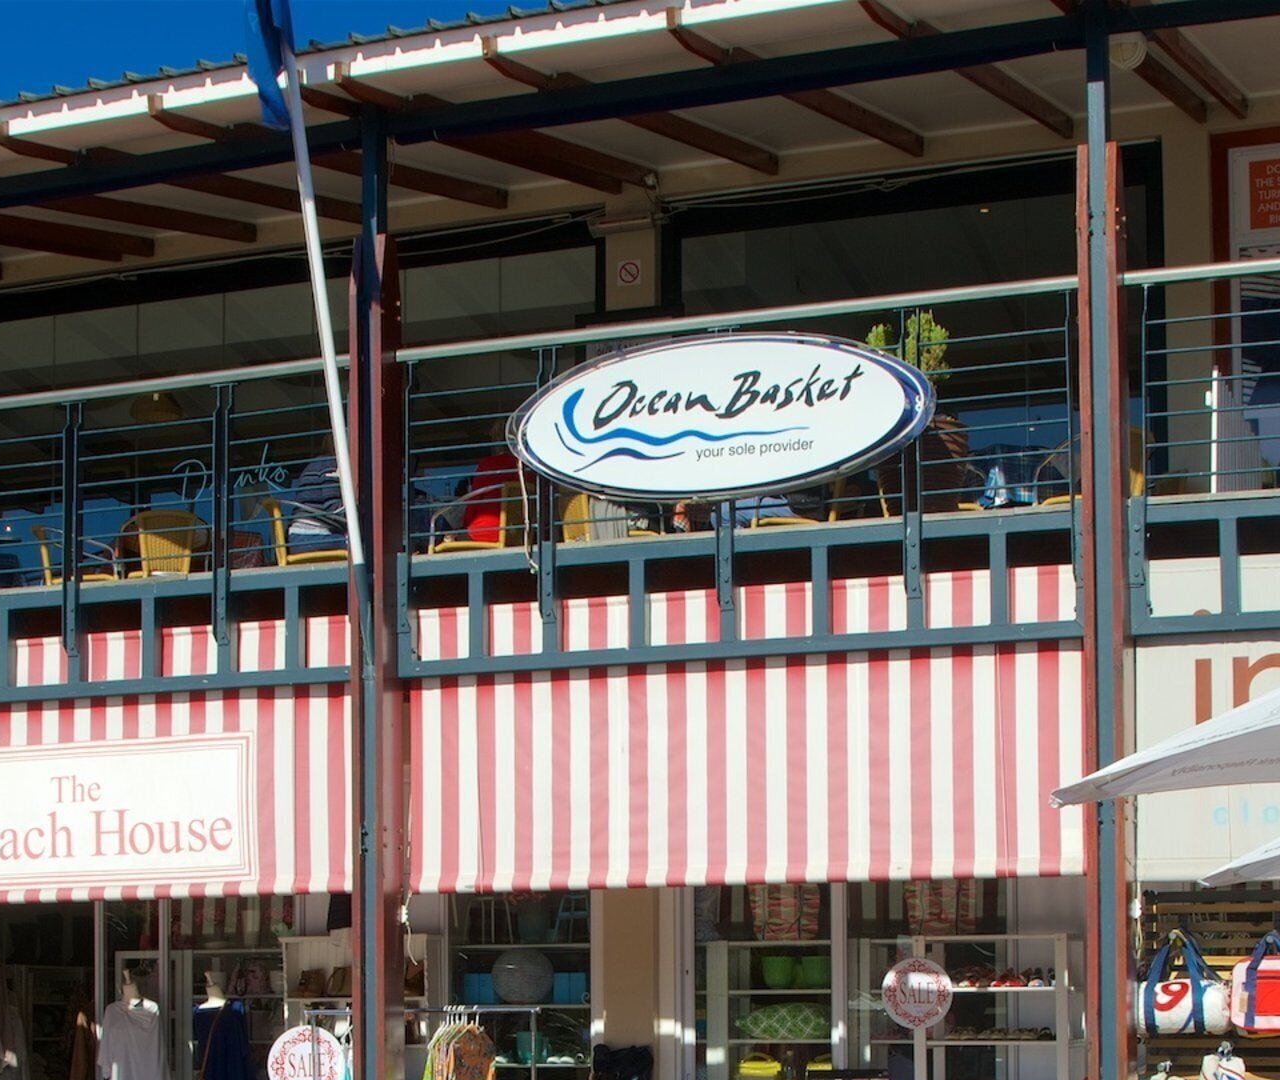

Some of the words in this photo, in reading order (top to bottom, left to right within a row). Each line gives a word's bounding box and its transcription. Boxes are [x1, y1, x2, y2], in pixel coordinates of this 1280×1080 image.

[1255, 177, 1274, 187] THE
[1257, 201, 1280, 212] AND
[591, 380, 719, 431] Ocean
[715, 364, 863, 419] Basket
[695, 446, 724, 462] your
[728, 441, 755, 457] sole
[759, 437, 813, 456] provider
[50, 774, 102, 804] The
[90, 808, 233, 857] House
[899, 980, 934, 1004] SALE
